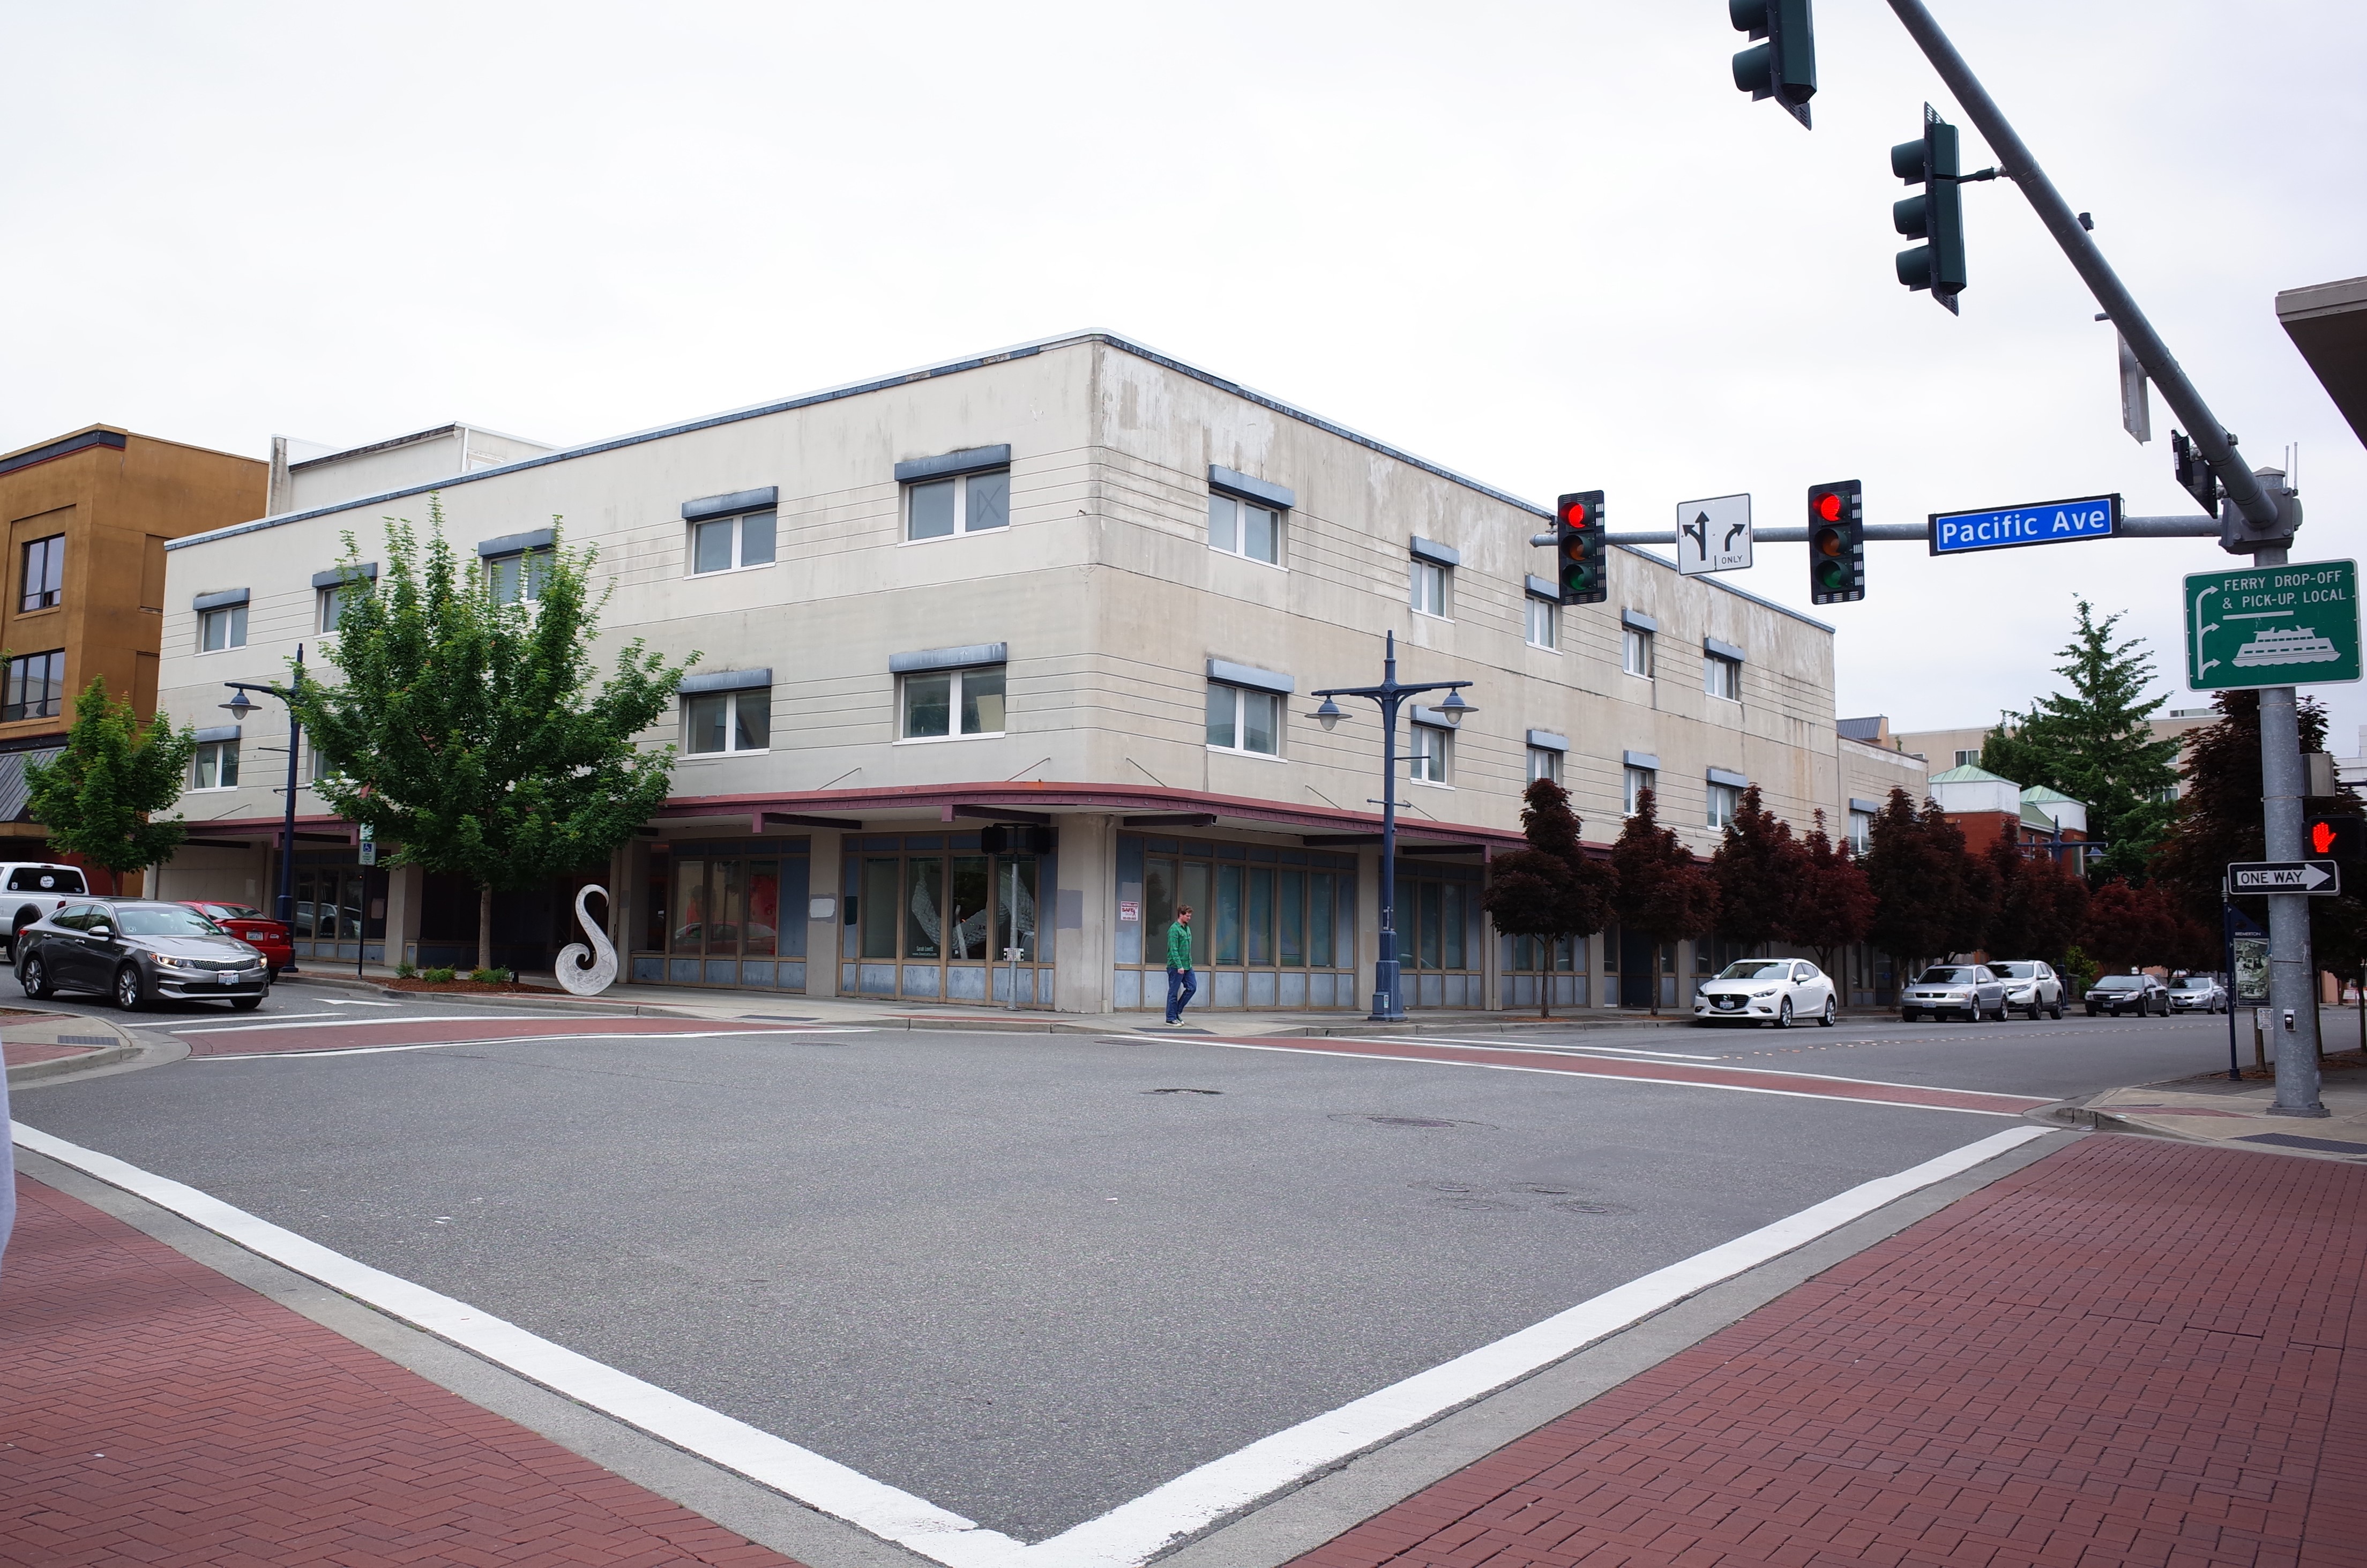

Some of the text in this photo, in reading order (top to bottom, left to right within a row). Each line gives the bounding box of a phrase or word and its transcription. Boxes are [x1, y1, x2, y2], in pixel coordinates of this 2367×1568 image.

[1943, 510, 2105, 544] Pacific Ave
[1721, 555, 1743, 564] ONLY
[2224, 570, 2342, 591] FERRY DROP-OFF
[2222, 598, 2233, 609] &
[2303, 588, 2347, 603] LOCAL
[2241, 871, 2303, 884] ONE WAY
